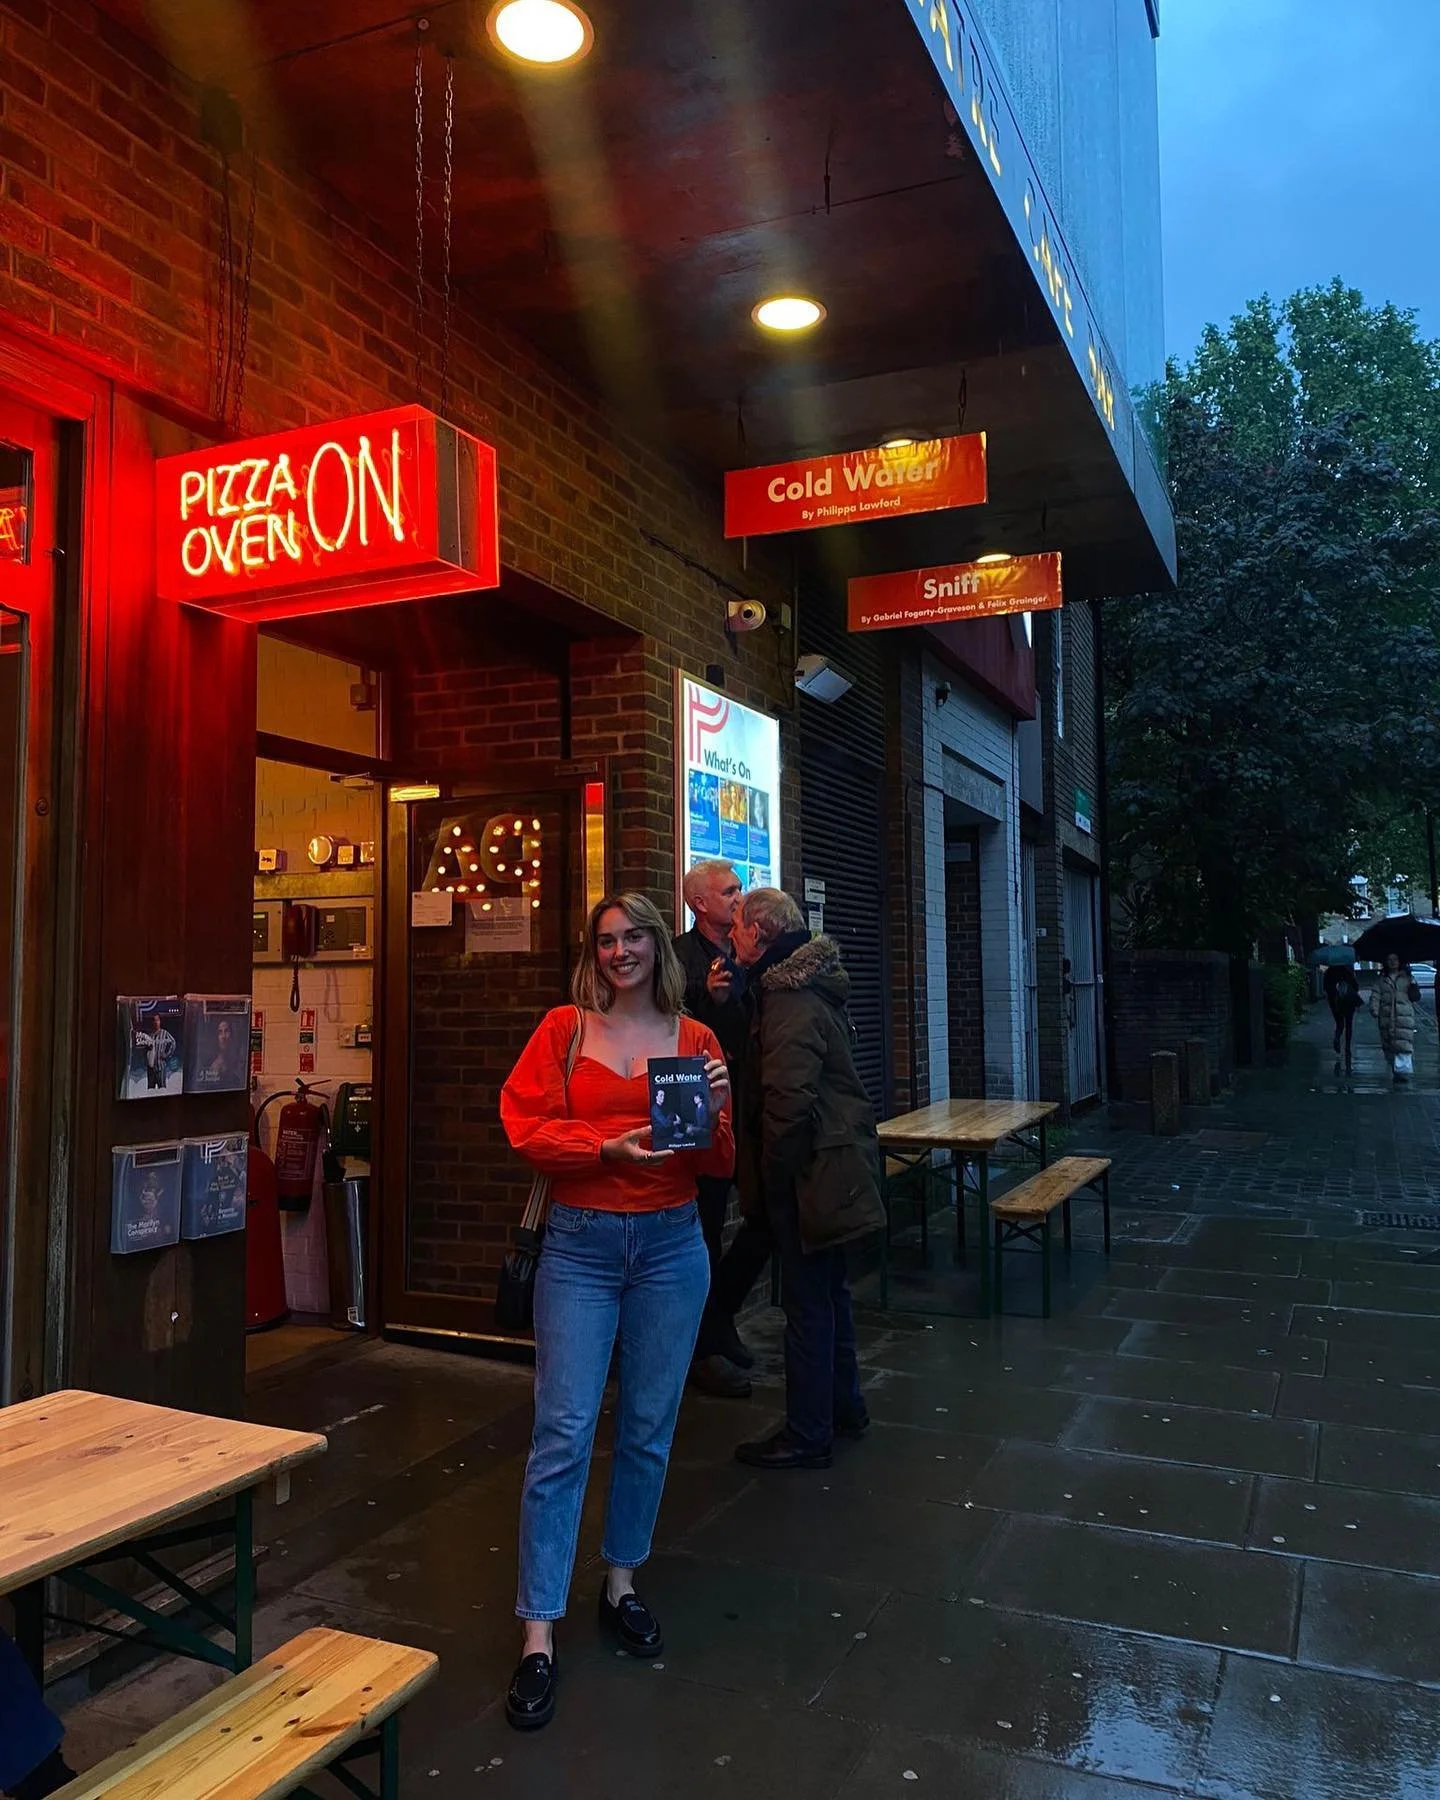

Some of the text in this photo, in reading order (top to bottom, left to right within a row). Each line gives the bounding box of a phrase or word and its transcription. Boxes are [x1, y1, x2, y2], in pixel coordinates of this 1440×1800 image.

[180, 453, 298, 521] PIZZA
[306, 427, 406, 552] ON
[767, 458, 942, 503] Cold Water
[801, 496, 902, 521] By Philippa Lawford
[181, 509, 302, 577] OVEN
[922, 571, 981, 600] Sniff
[860, 594, 1049, 625] By Gabriel Fogarty-Graveson & Felix Grainger
[703, 748, 752, 781] What's On
[654, 1073, 702, 1083] Cold Water
